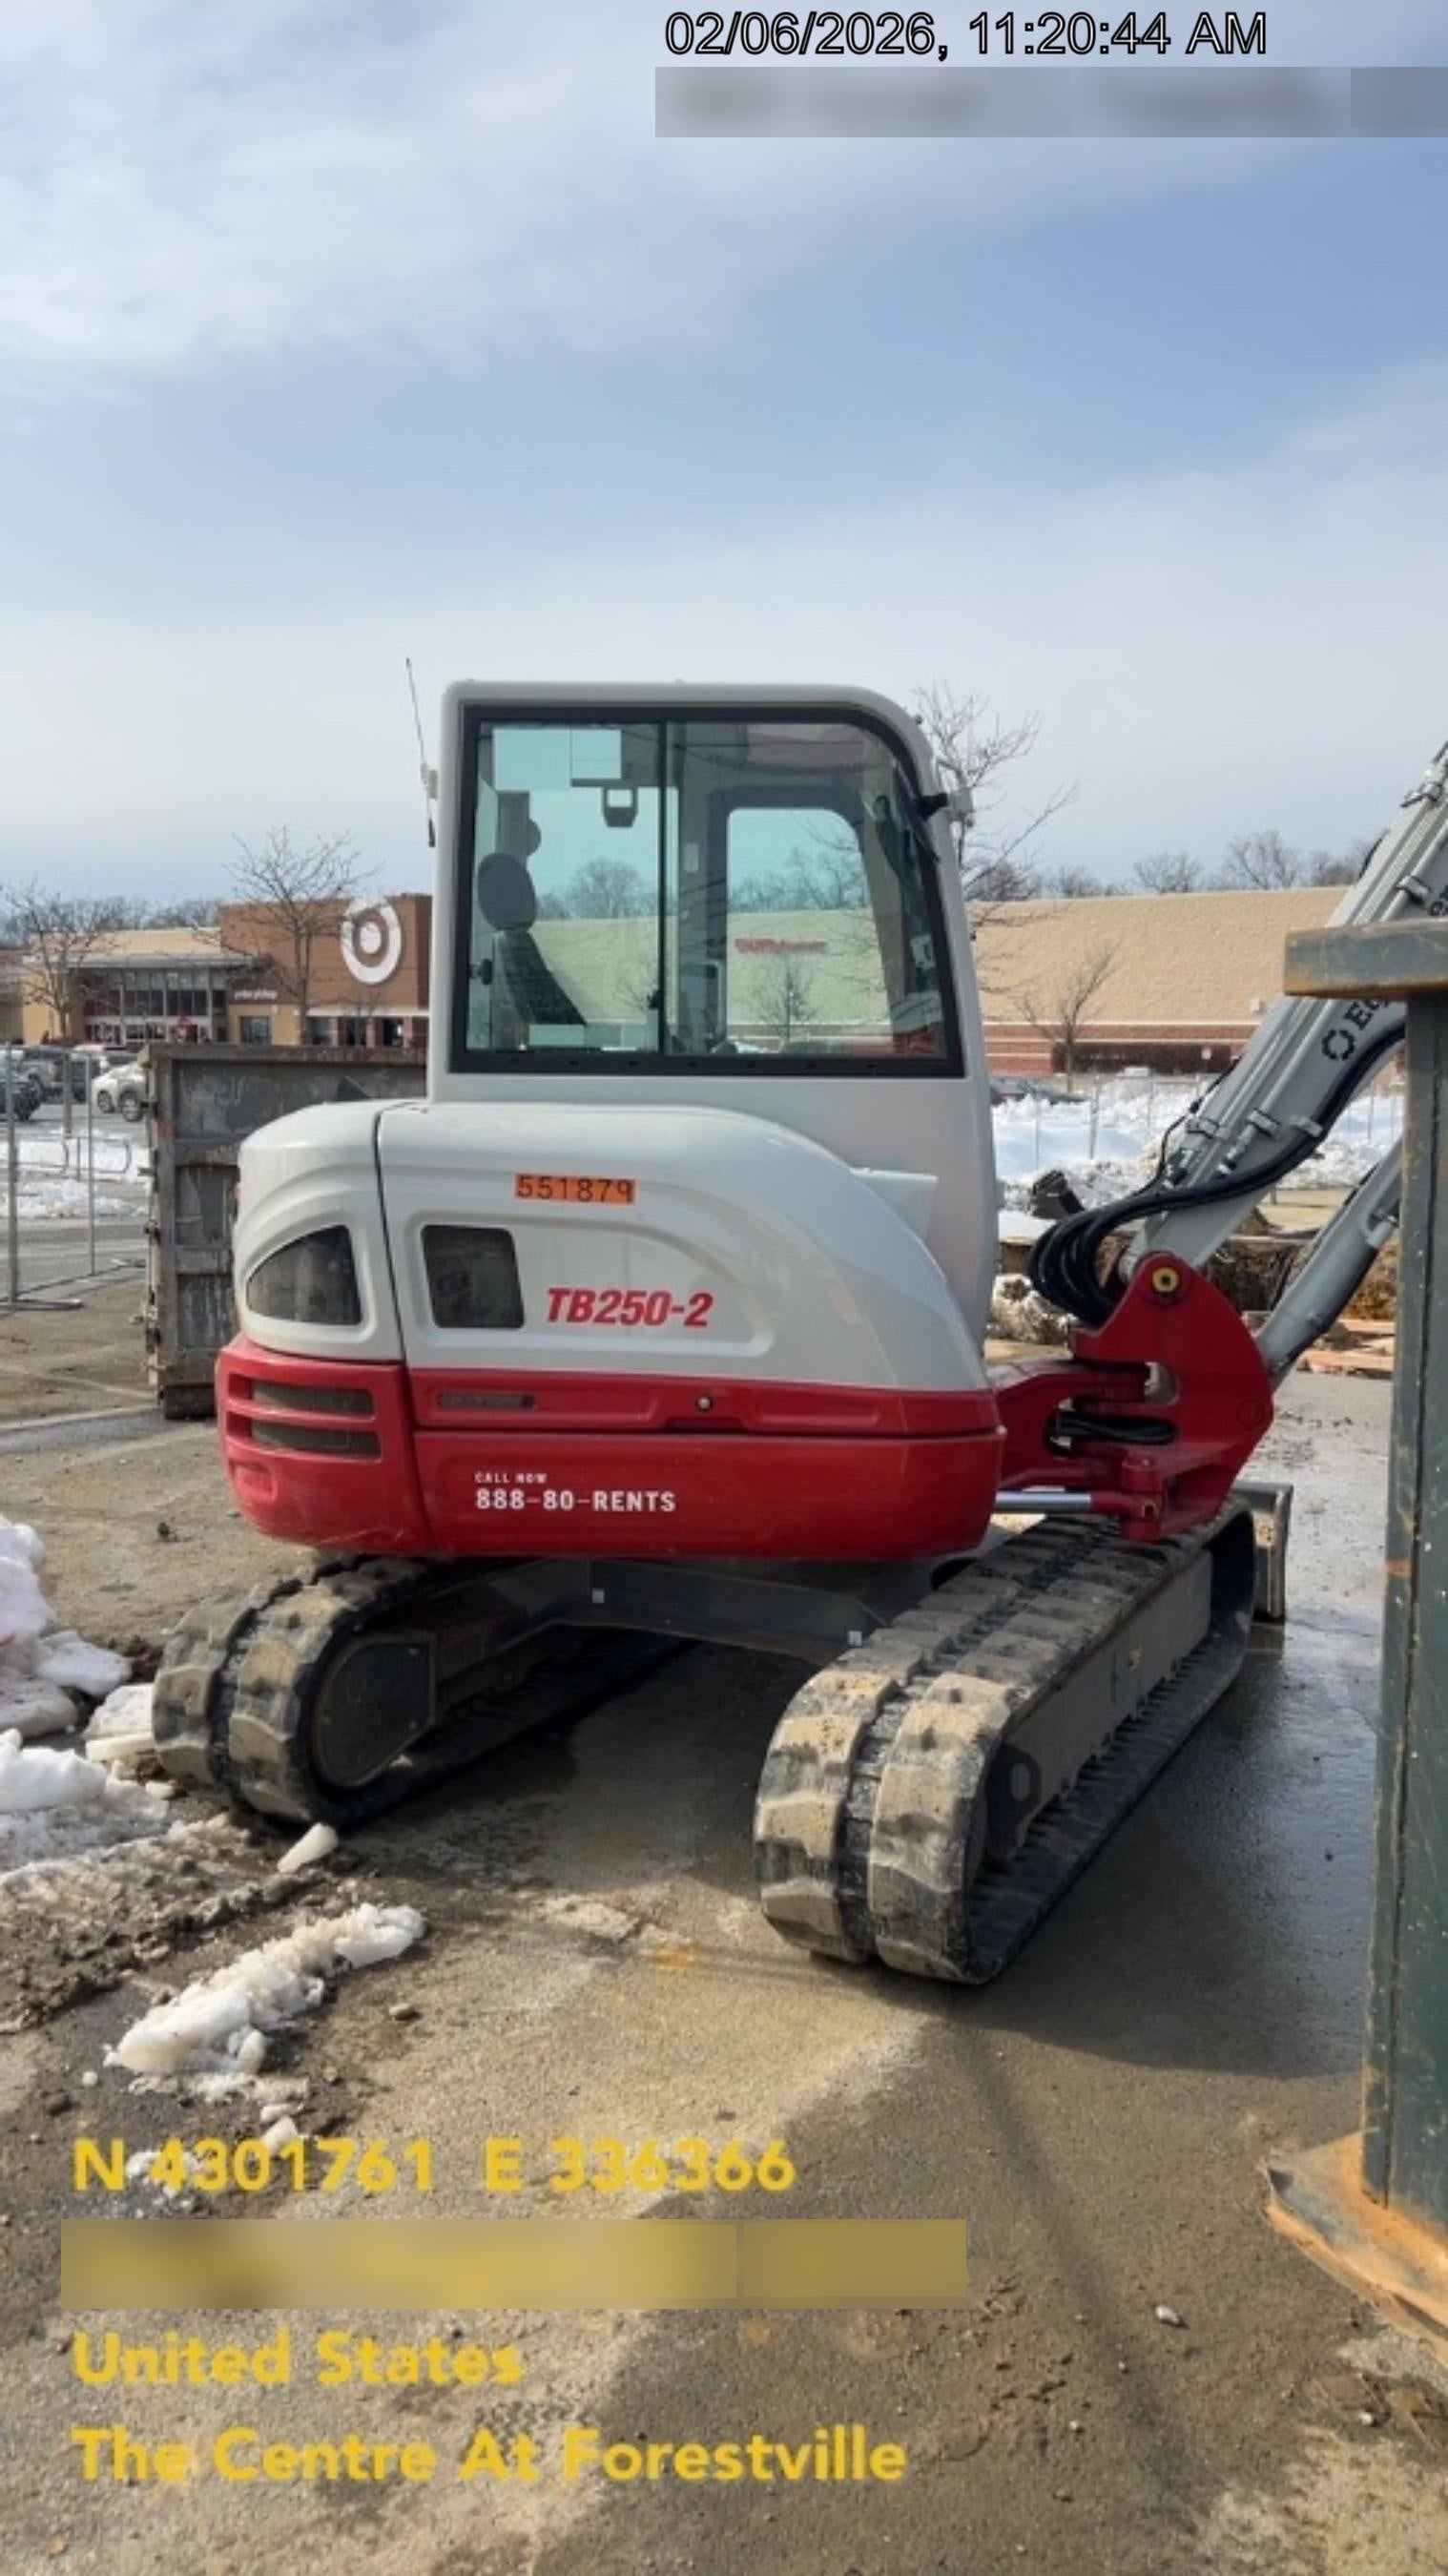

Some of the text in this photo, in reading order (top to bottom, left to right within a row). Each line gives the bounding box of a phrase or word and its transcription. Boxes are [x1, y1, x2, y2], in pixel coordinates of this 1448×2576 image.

[516, 1175, 633, 1202] 551879
[547, 1287, 714, 1327] TB250-2
[475, 1472, 548, 1484] CALL NOW
[476, 1487, 676, 1512] 888-80-RENTS
